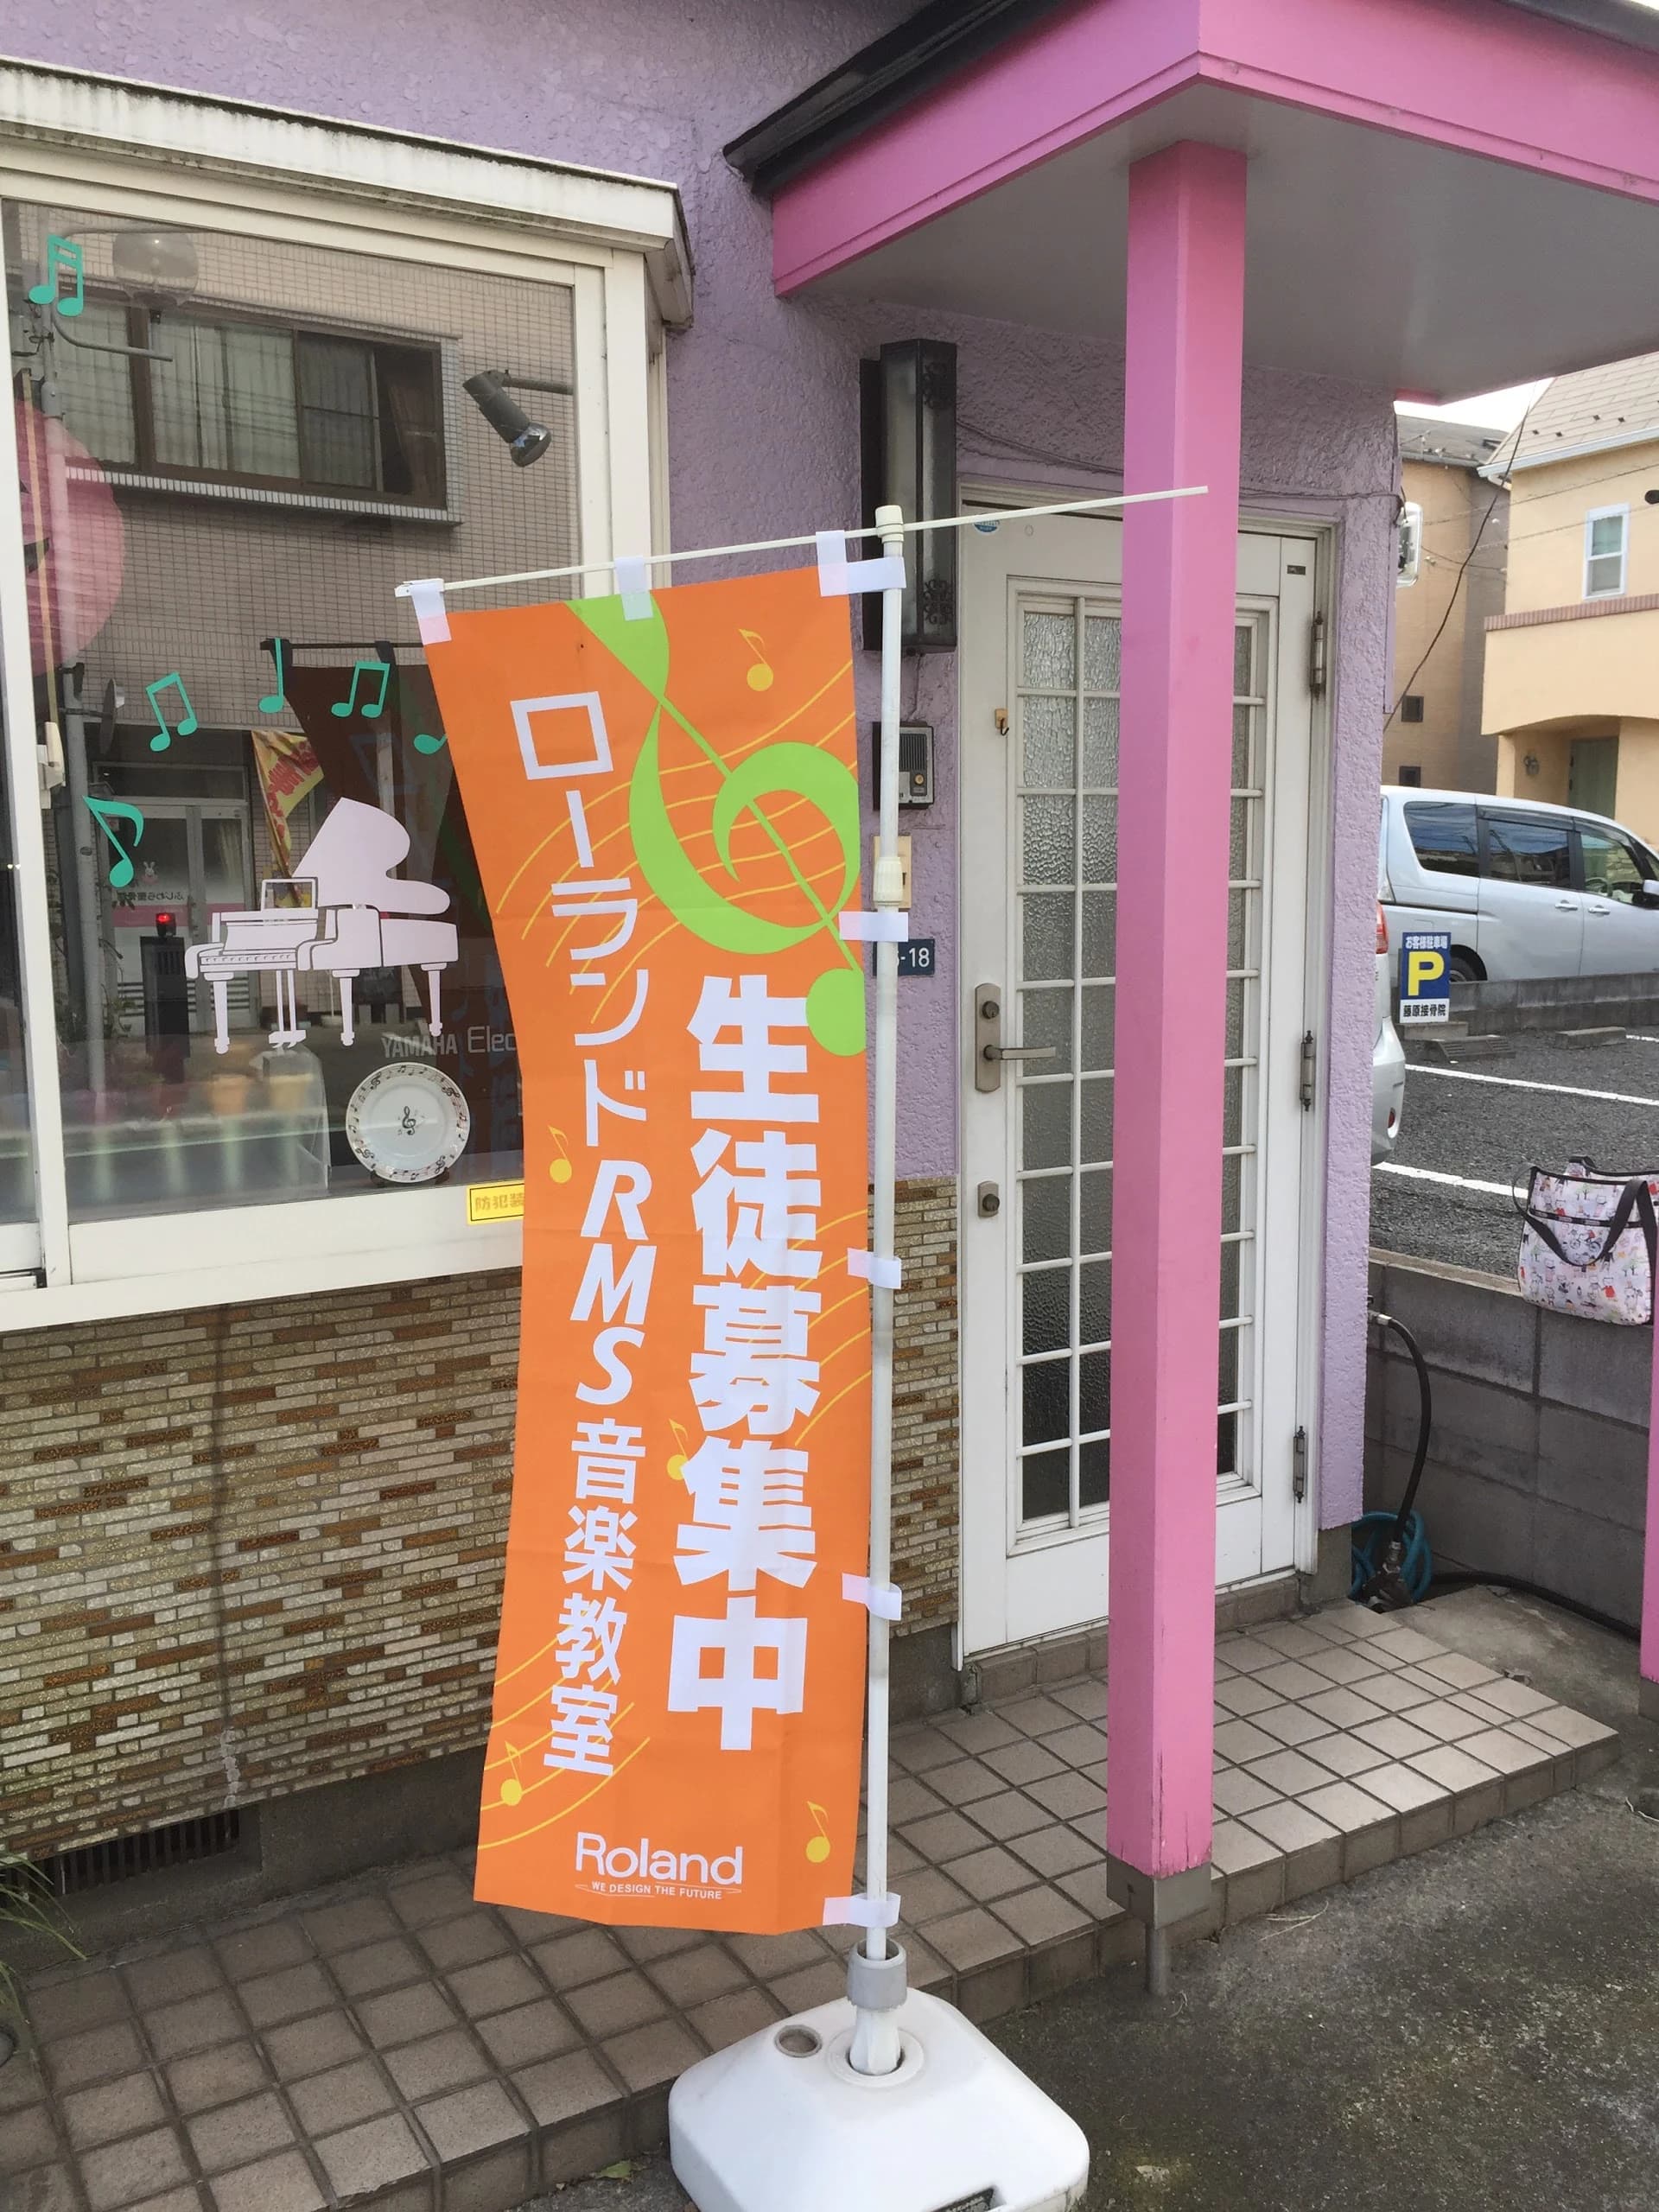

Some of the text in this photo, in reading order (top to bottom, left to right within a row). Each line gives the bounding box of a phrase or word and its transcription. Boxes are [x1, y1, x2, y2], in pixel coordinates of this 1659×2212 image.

[897, 947, 930, 968] -18
[1408, 951, 1445, 996] P
[380, 1033, 459, 1058] YAMAHA
[510, 690, 658, 1777] ローランドRMS音楽教室
[666, 973, 823, 1751] 生徒募集中
[575, 1831, 744, 1885] Roland
[591, 1880, 722, 1900] WE DESIGN THE FUTURE
